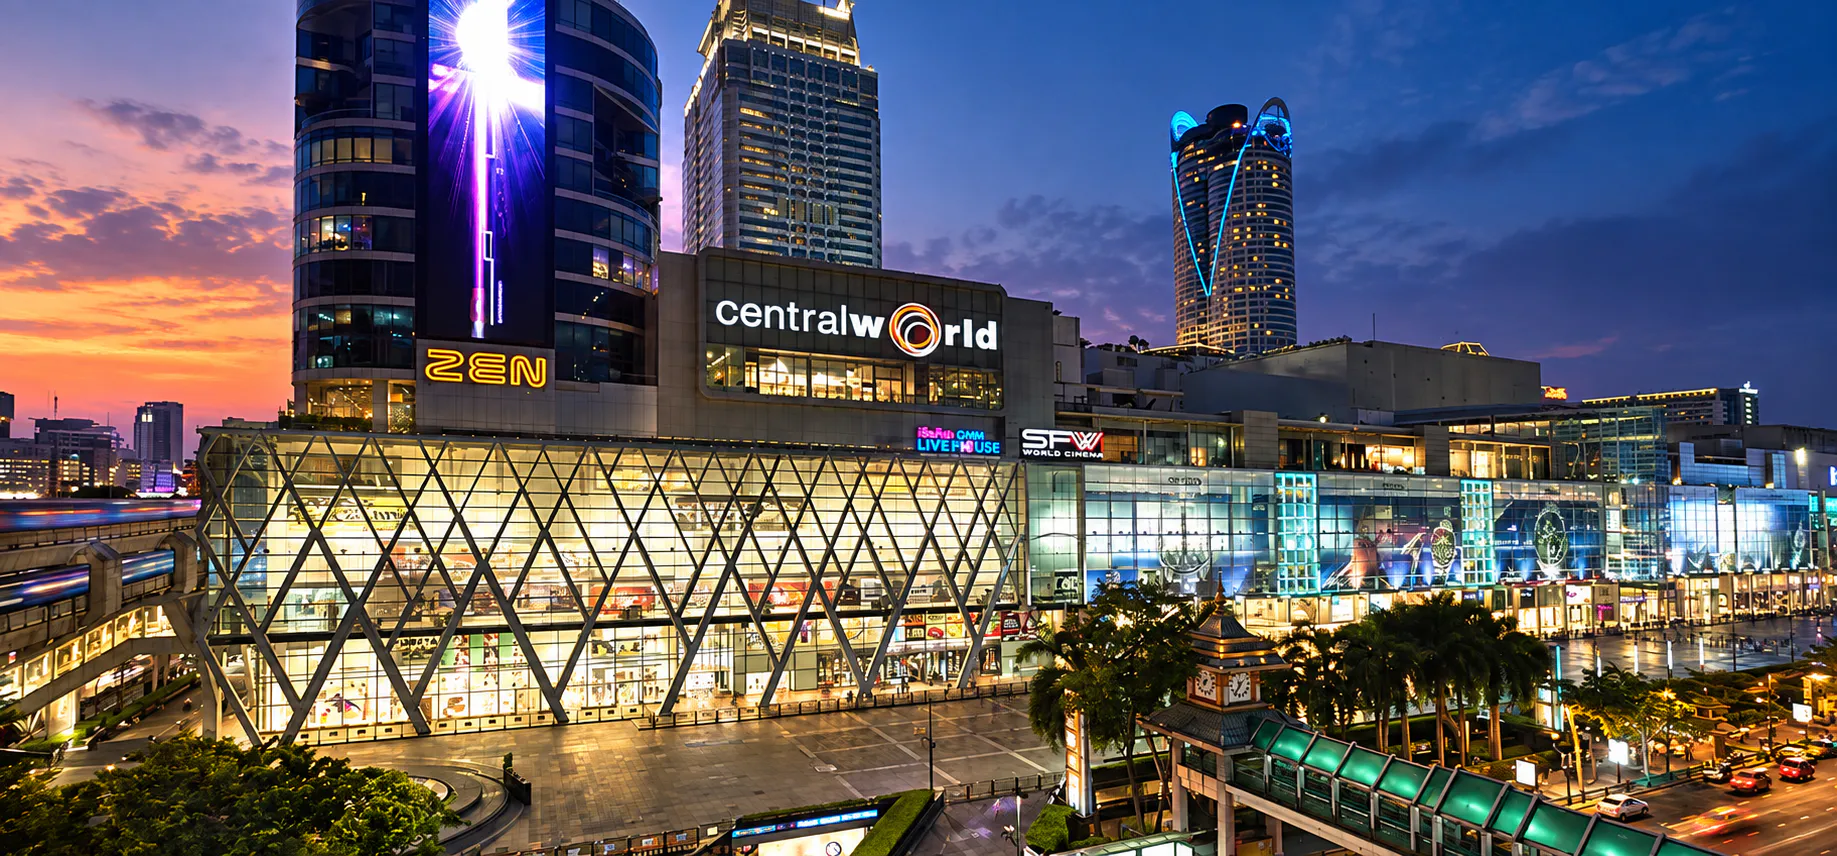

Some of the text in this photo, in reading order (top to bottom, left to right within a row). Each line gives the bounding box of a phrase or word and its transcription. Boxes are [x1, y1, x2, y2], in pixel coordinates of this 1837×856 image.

[716, 299, 998, 358] centralworld
[425, 348, 547, 388] ZEN
[956, 429, 985, 440] GMM
[917, 438, 950, 452] LIVE
[1022, 449, 1104, 459] WORLD CINEMA
